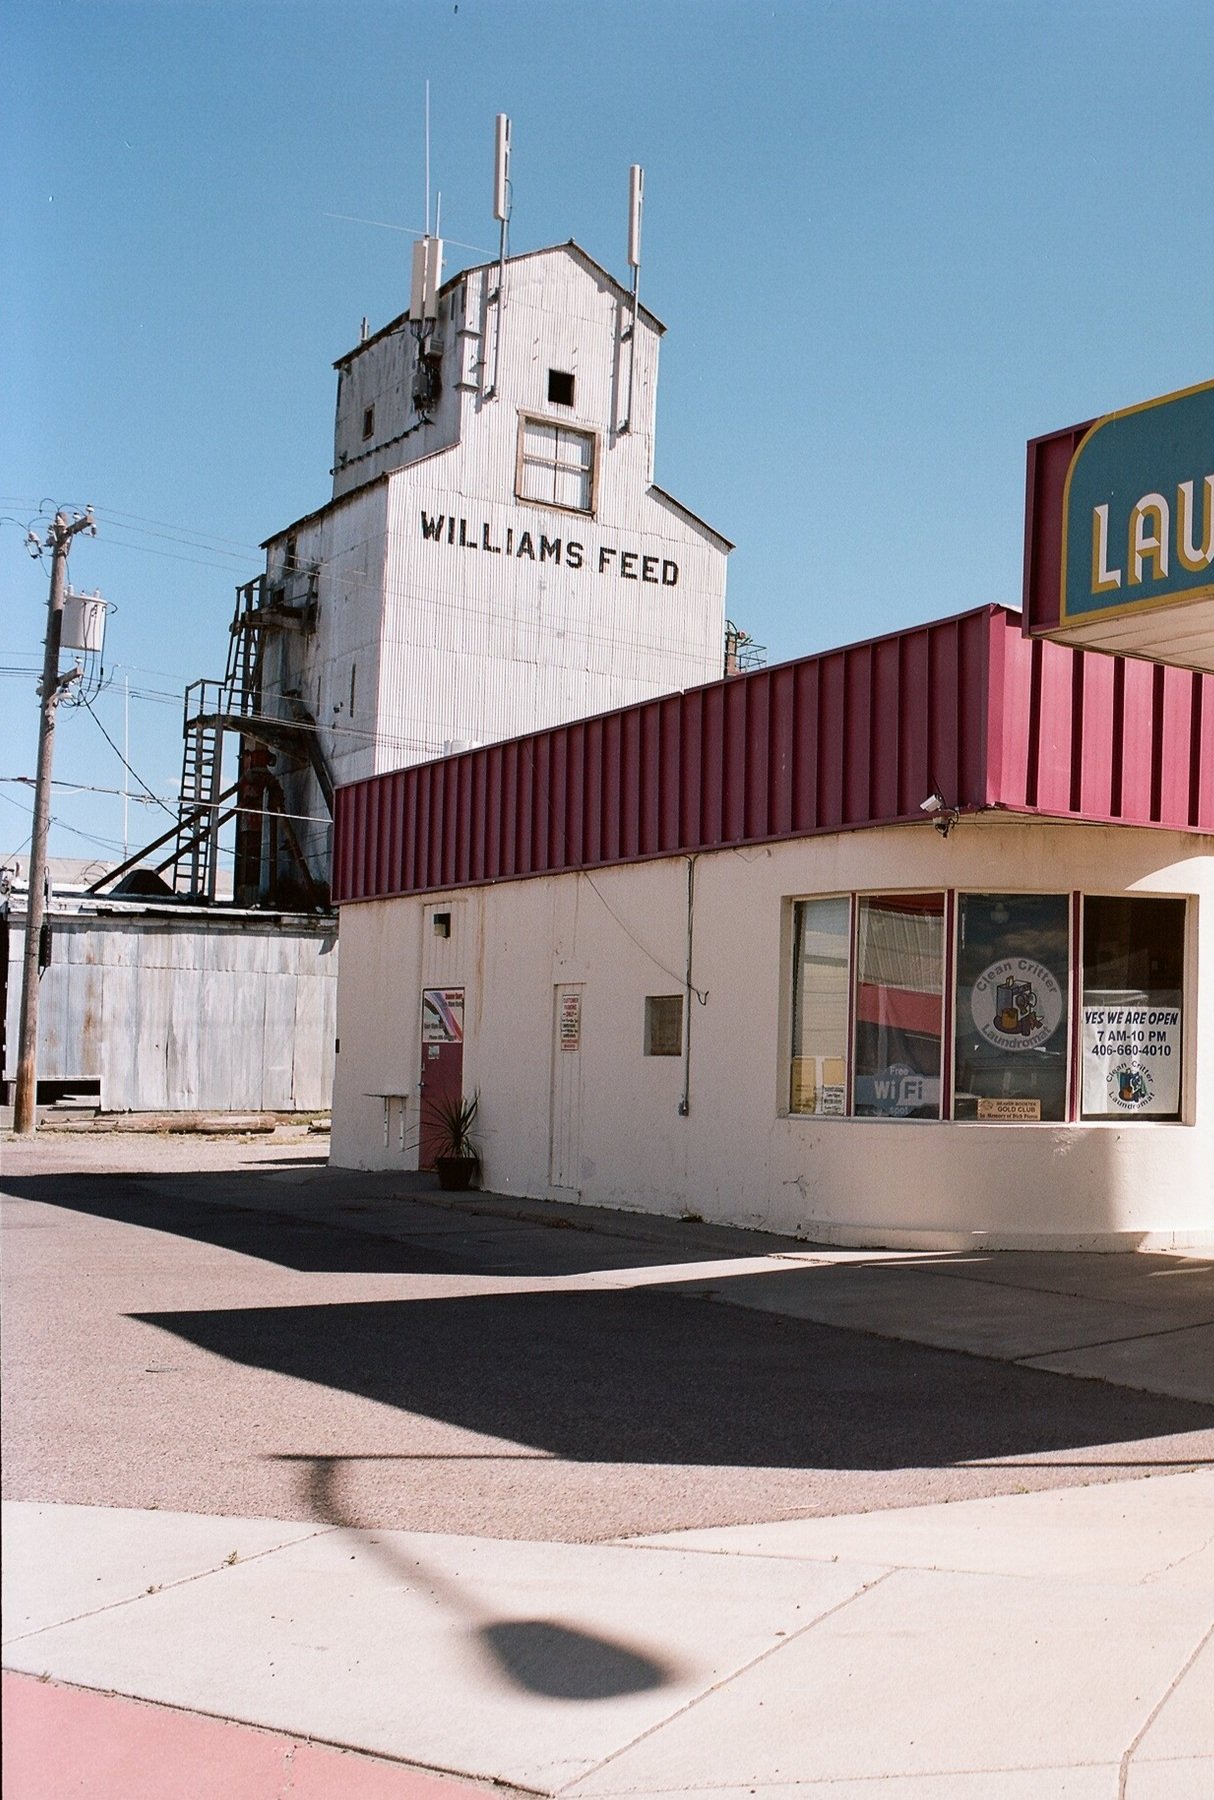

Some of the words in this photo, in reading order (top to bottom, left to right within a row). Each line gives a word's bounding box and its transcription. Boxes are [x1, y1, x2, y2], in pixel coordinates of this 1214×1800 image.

[420, 510, 584, 569] WILLIAMS
[598, 546, 680, 588] FEED
[977, 961, 1013, 992] Clean
[1017, 959, 1058, 994] Critter
[1085, 1011, 1105, 1025] YES
[1107, 1011, 1124, 1025] WE
[1125, 1011, 1148, 1025] ARE
[1148, 1012, 1179, 1026] OPEN
[981, 1023, 1052, 1049] Laundromat
[1097, 1031, 1105, 1042] 7
[1108, 1030, 1145, 1042] AM-10
[1148, 1031, 1167, 1042] PM
[1091, 1044, 1172, 1057] 406-660-4010
[889, 1064, 909, 1076] Free
[1106, 1062, 1127, 1083] Clean
[1131, 1060, 1154, 1084] Critter
